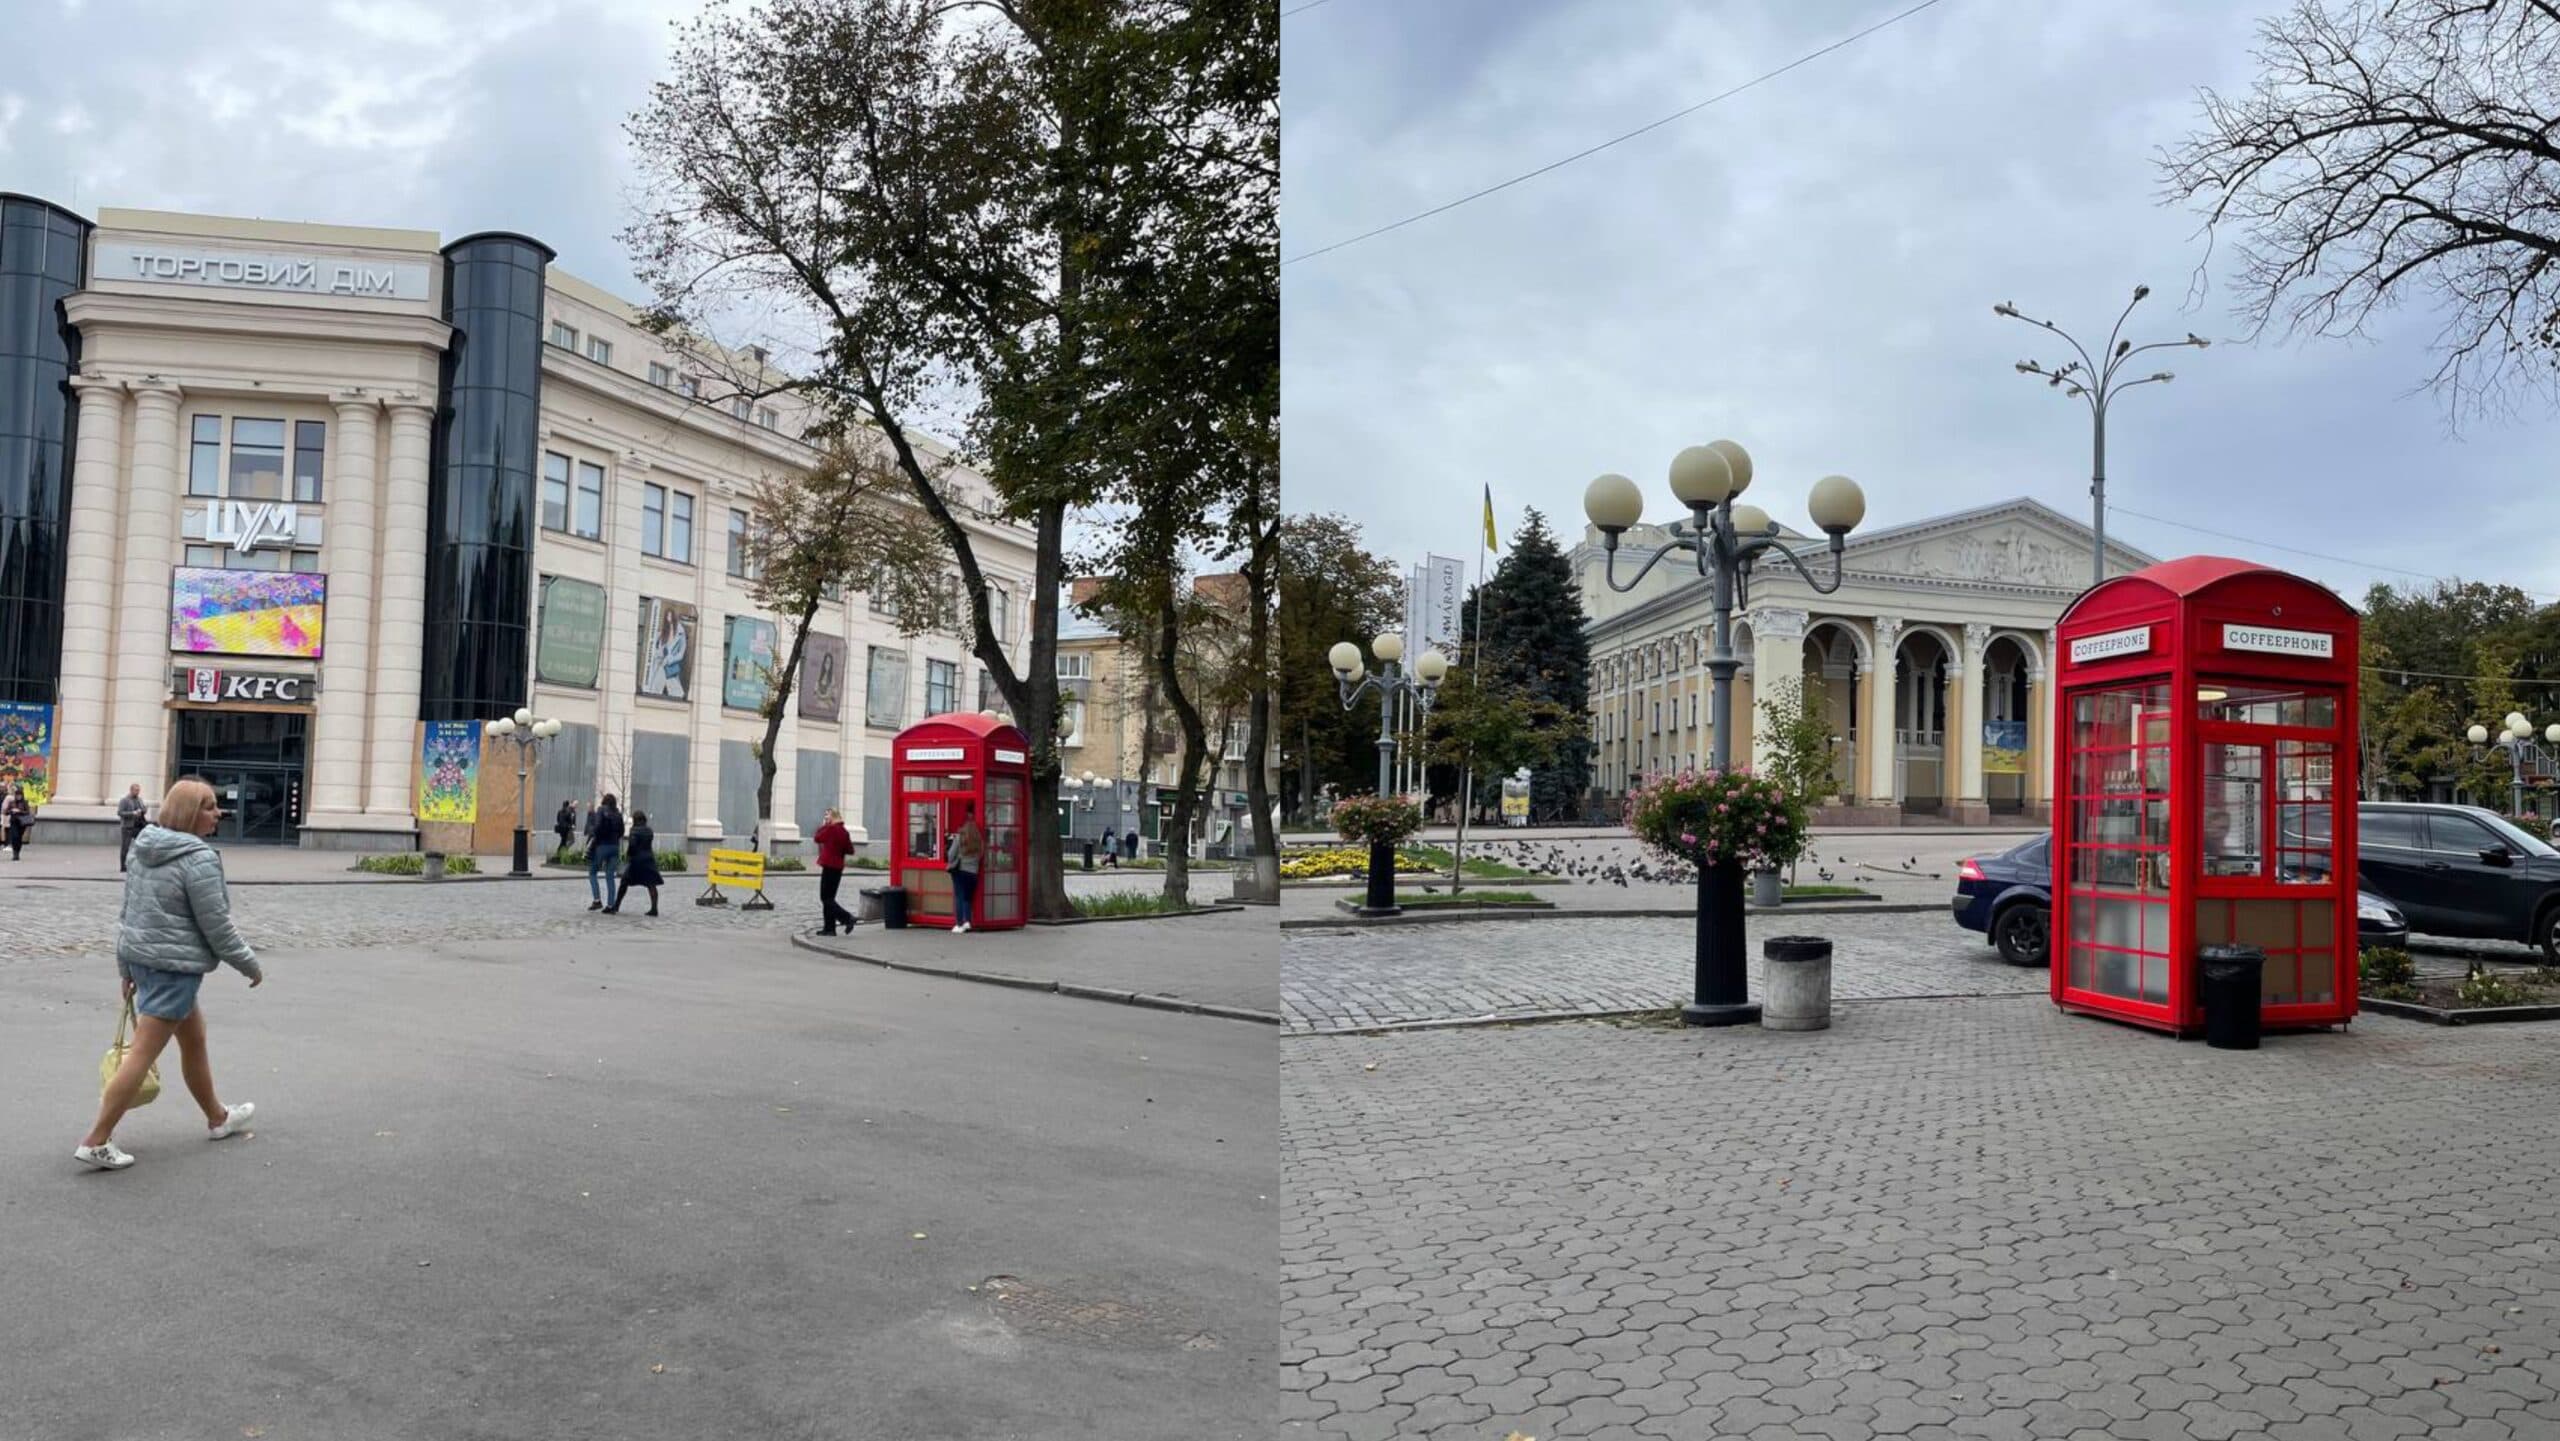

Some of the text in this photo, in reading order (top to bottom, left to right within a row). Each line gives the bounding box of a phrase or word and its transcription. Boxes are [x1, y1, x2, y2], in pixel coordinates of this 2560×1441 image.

[132, 255, 395, 295] ТОРГОВИЙ ДІМ
[206, 500, 297, 552] ЦУМ
[2074, 633, 2145, 657] COFFEEPHONE
[2229, 631, 2328, 652] COFFEEPHONE
[224, 676, 299, 700] KFC
